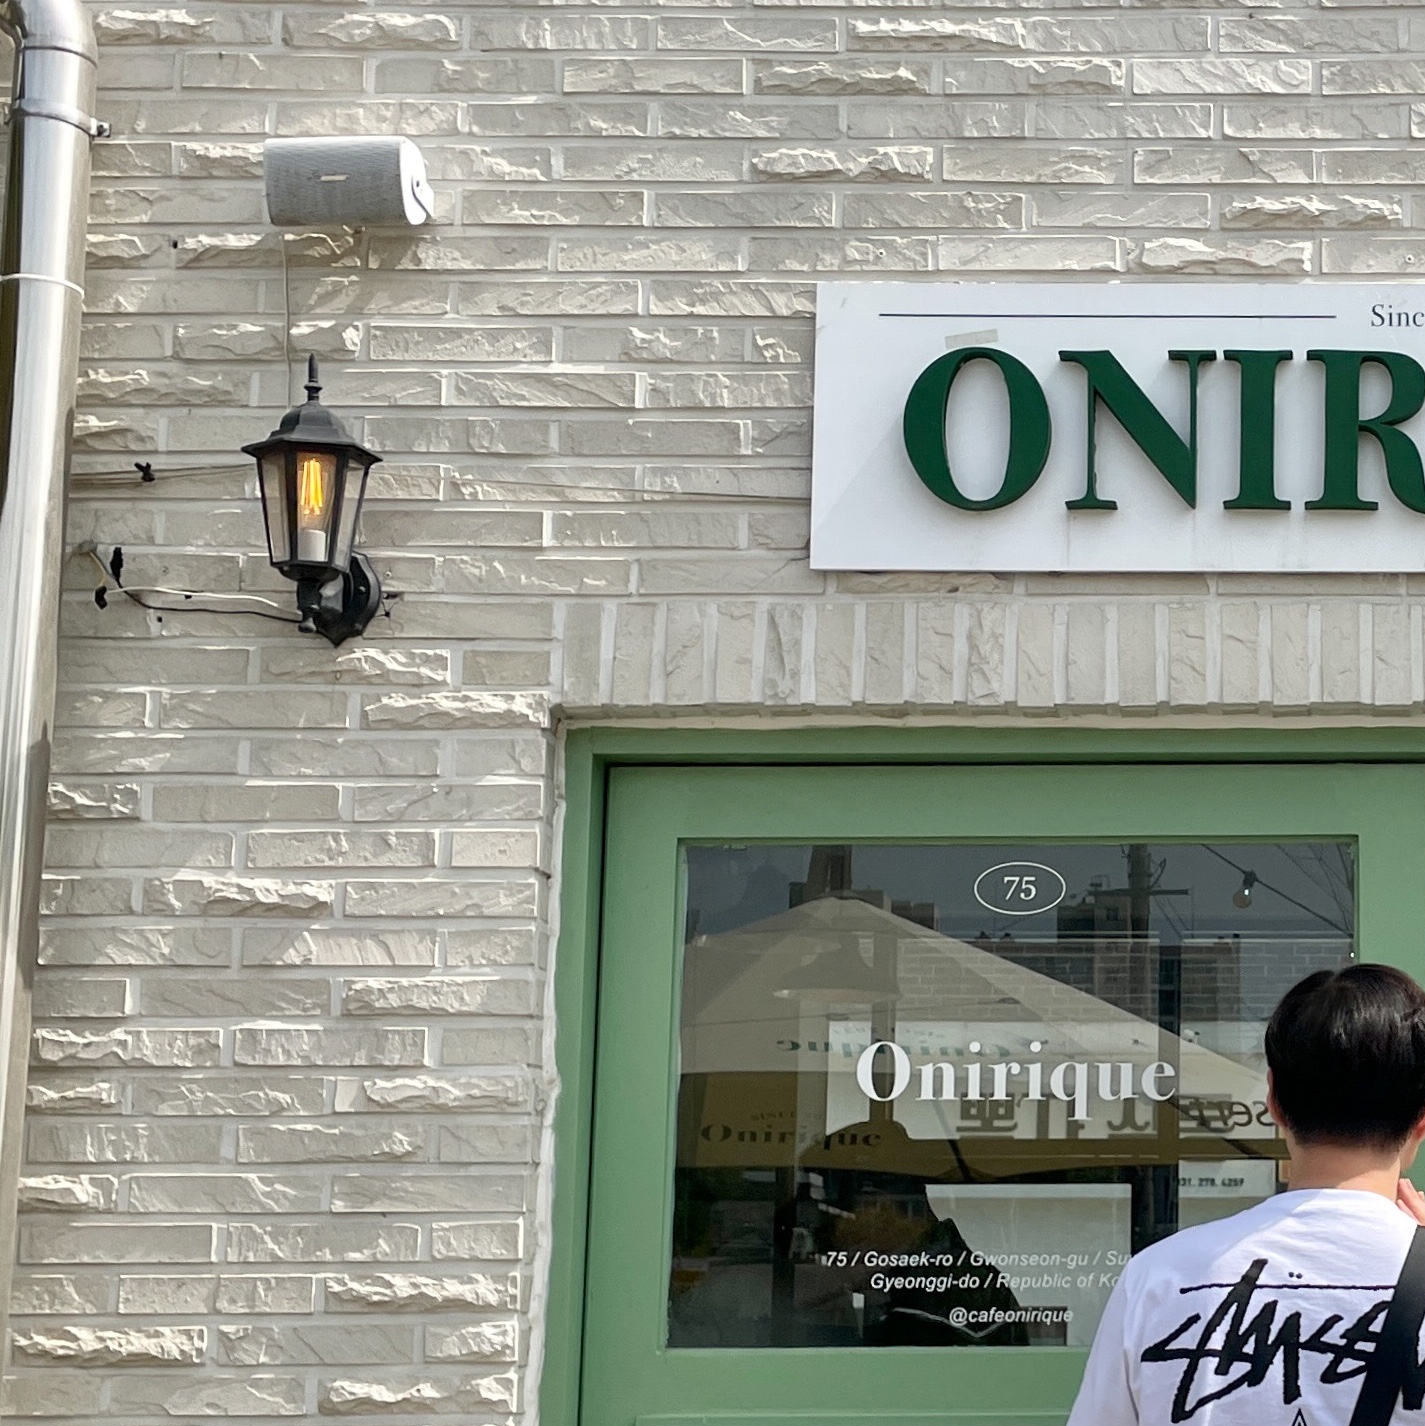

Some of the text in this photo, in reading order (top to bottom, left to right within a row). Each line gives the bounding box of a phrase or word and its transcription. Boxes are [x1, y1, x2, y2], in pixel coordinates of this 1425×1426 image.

[1002, 874, 1037, 902] 75
[855, 1040, 1178, 1121] Onirique
[826, 1251, 848, 1267] 75
[863, 1251, 953, 1268] Gosaek-ro
[970, 1250, 1089, 1271] Gwonseon-gu
[870, 1273, 980, 1293] Gyeonggi-do
[996, 1273, 1071, 1289] Republic
[1076, 1273, 1094, 1288] of
[949, 1306, 1074, 1327] @cafeonirique
